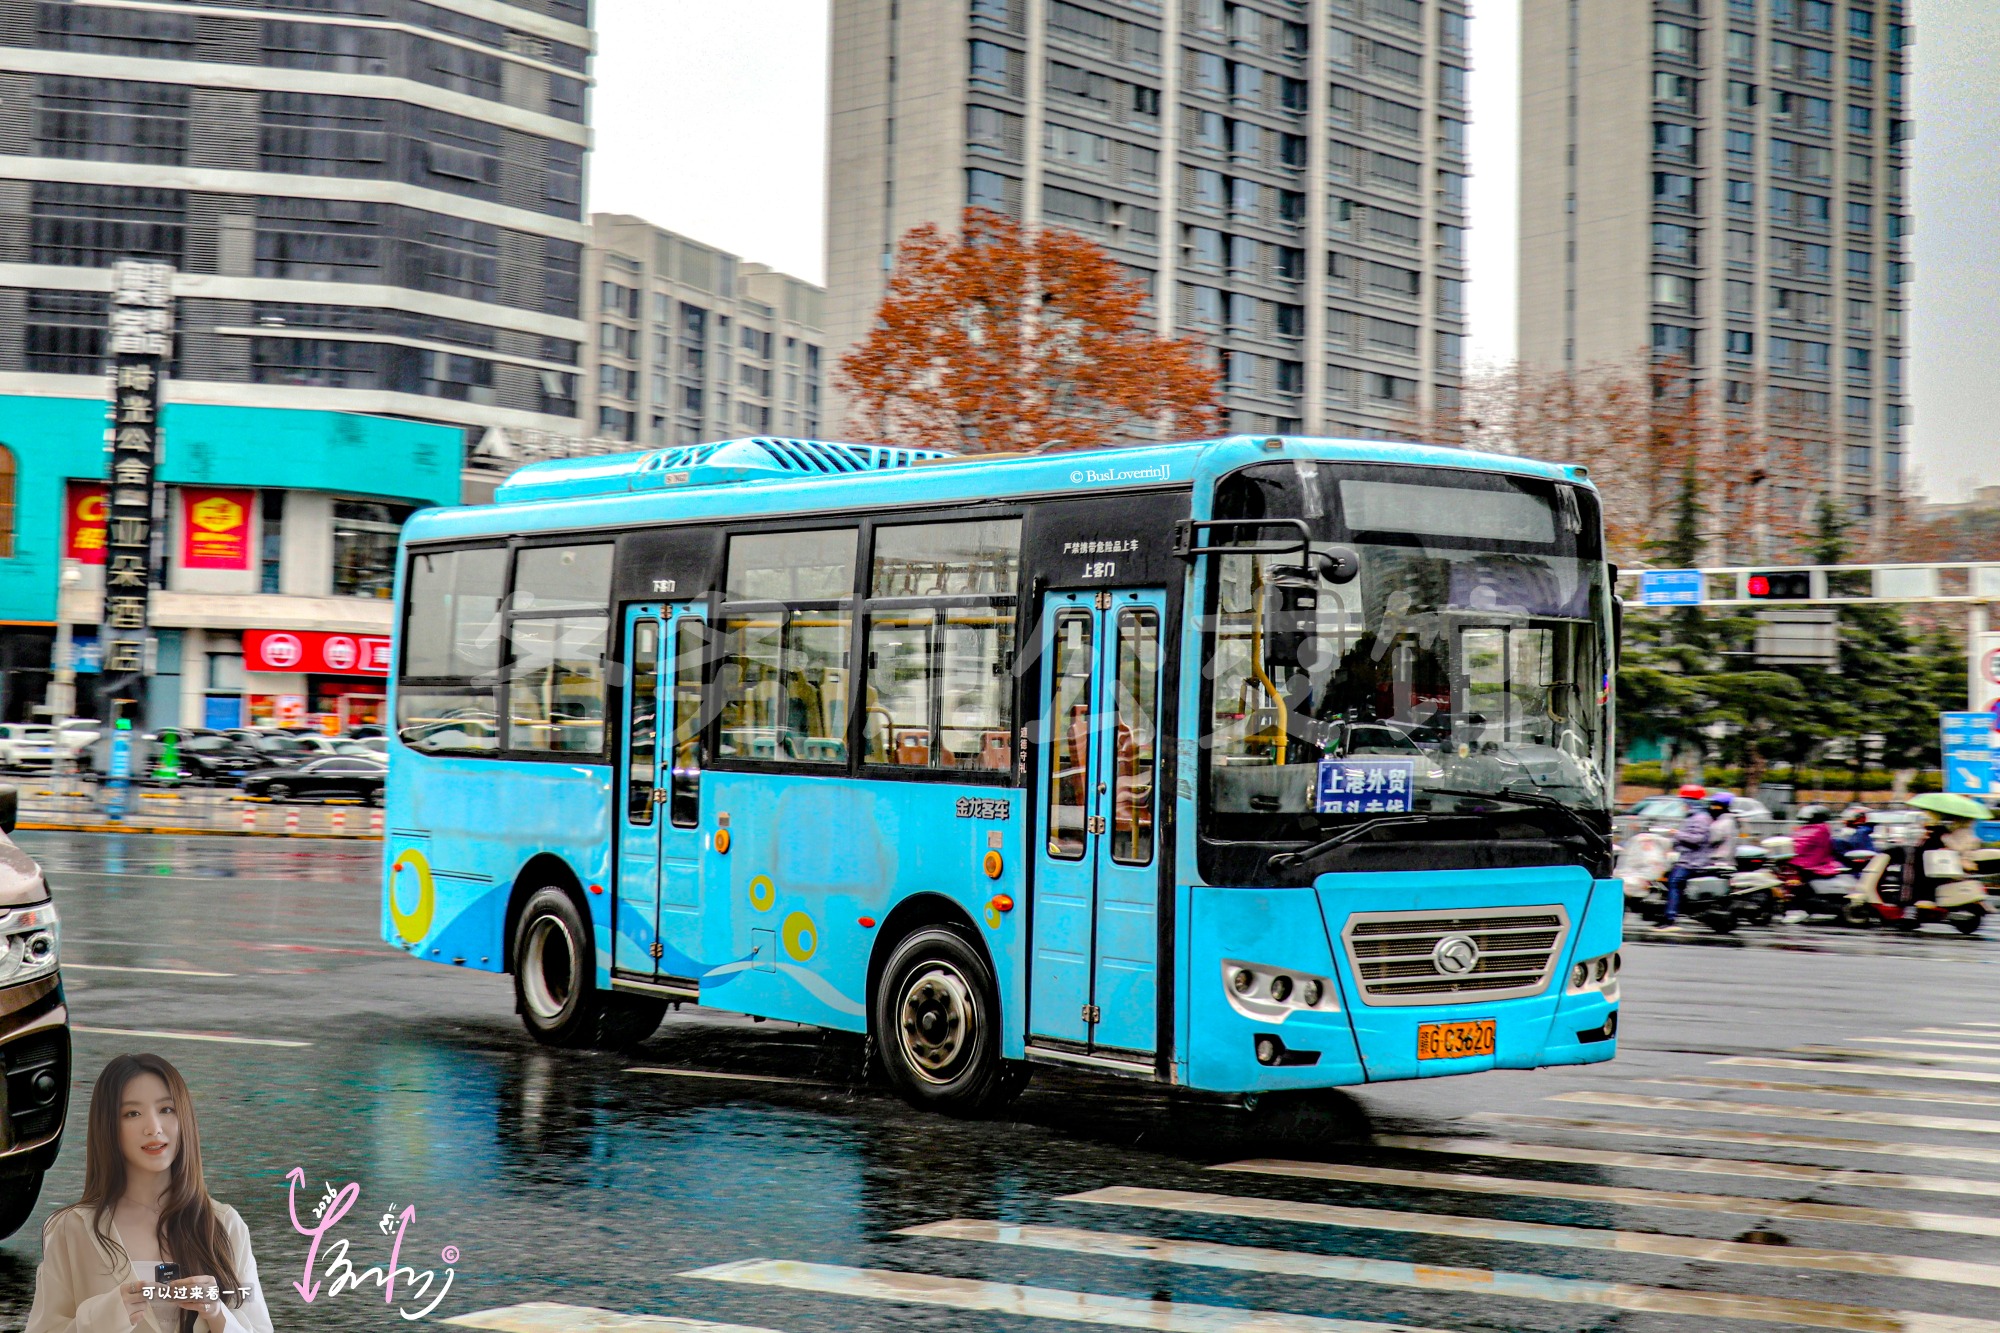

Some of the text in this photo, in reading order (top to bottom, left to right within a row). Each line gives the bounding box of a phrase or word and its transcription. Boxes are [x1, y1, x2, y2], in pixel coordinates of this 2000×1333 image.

[1063, 539, 1139, 555] 严禁携带危险品上车
[1082, 562, 1115, 578] 上客门
[1324, 768, 1407, 795] 上港外贸
[956, 796, 1010, 820] 金龙客车
